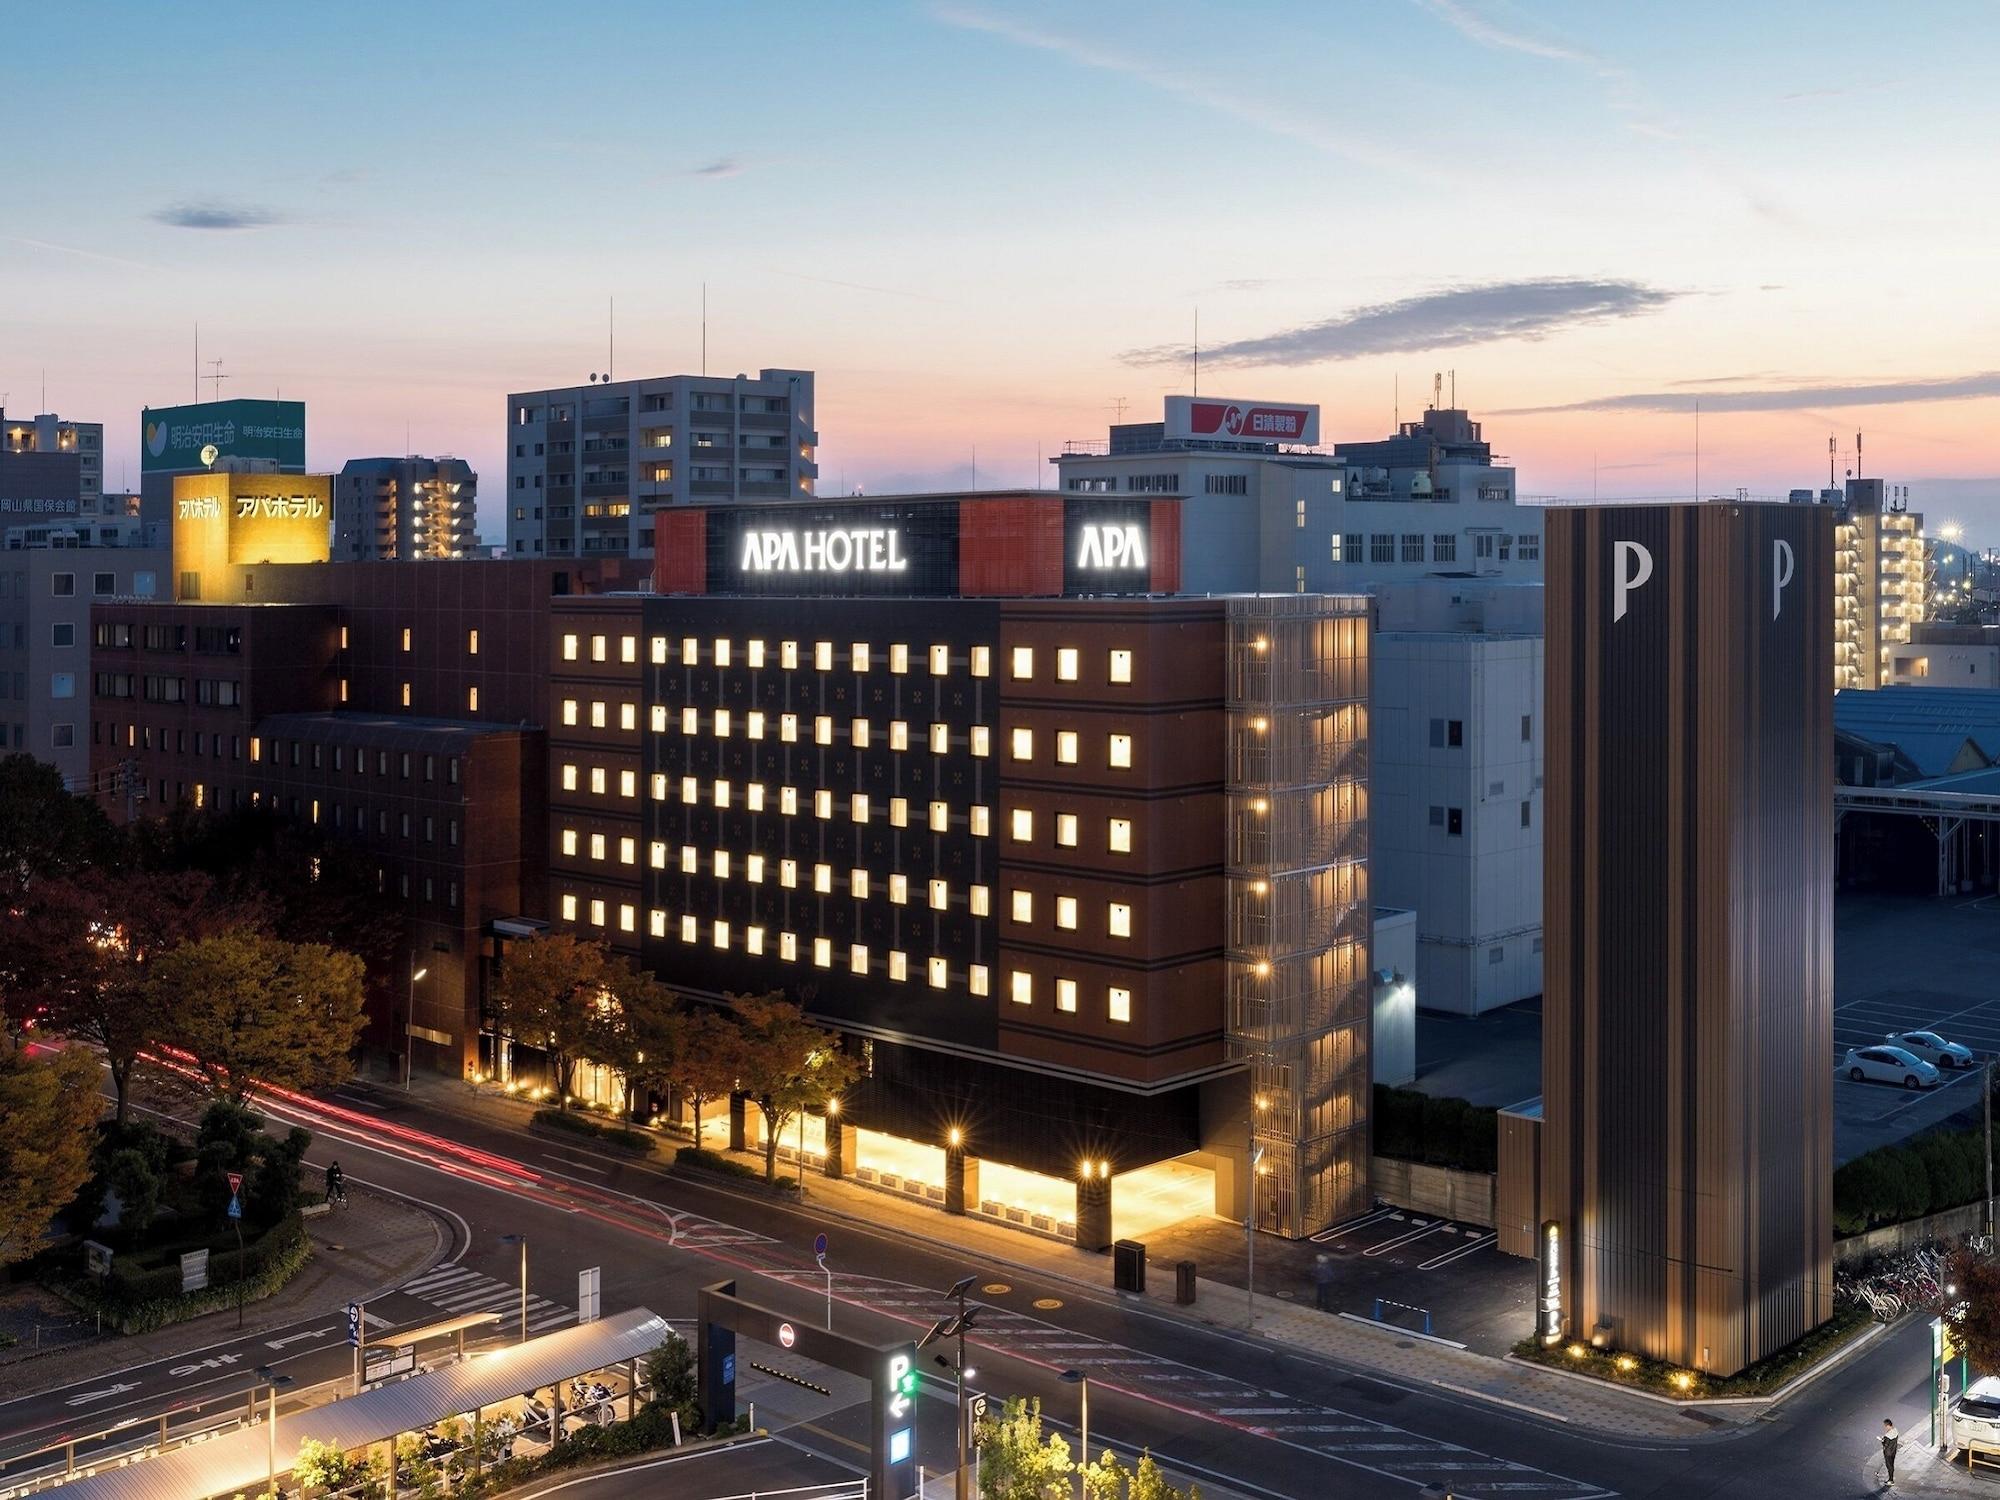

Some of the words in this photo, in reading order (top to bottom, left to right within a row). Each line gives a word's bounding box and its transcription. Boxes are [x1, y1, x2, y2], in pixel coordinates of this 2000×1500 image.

[171, 420, 235, 448] 明治安田生命
[1253, 414, 1296, 432] 日清製粉
[178, 496, 221, 520] アパホテル
[237, 496, 323, 518] アパホテル
[740, 532, 798, 571] APA
[802, 529, 907, 571] HOTEL
[1078, 525, 1146, 567] APA
[1614, 541, 1653, 624] P
[1774, 540, 1794, 622] P
[891, 1356, 909, 1392] P
